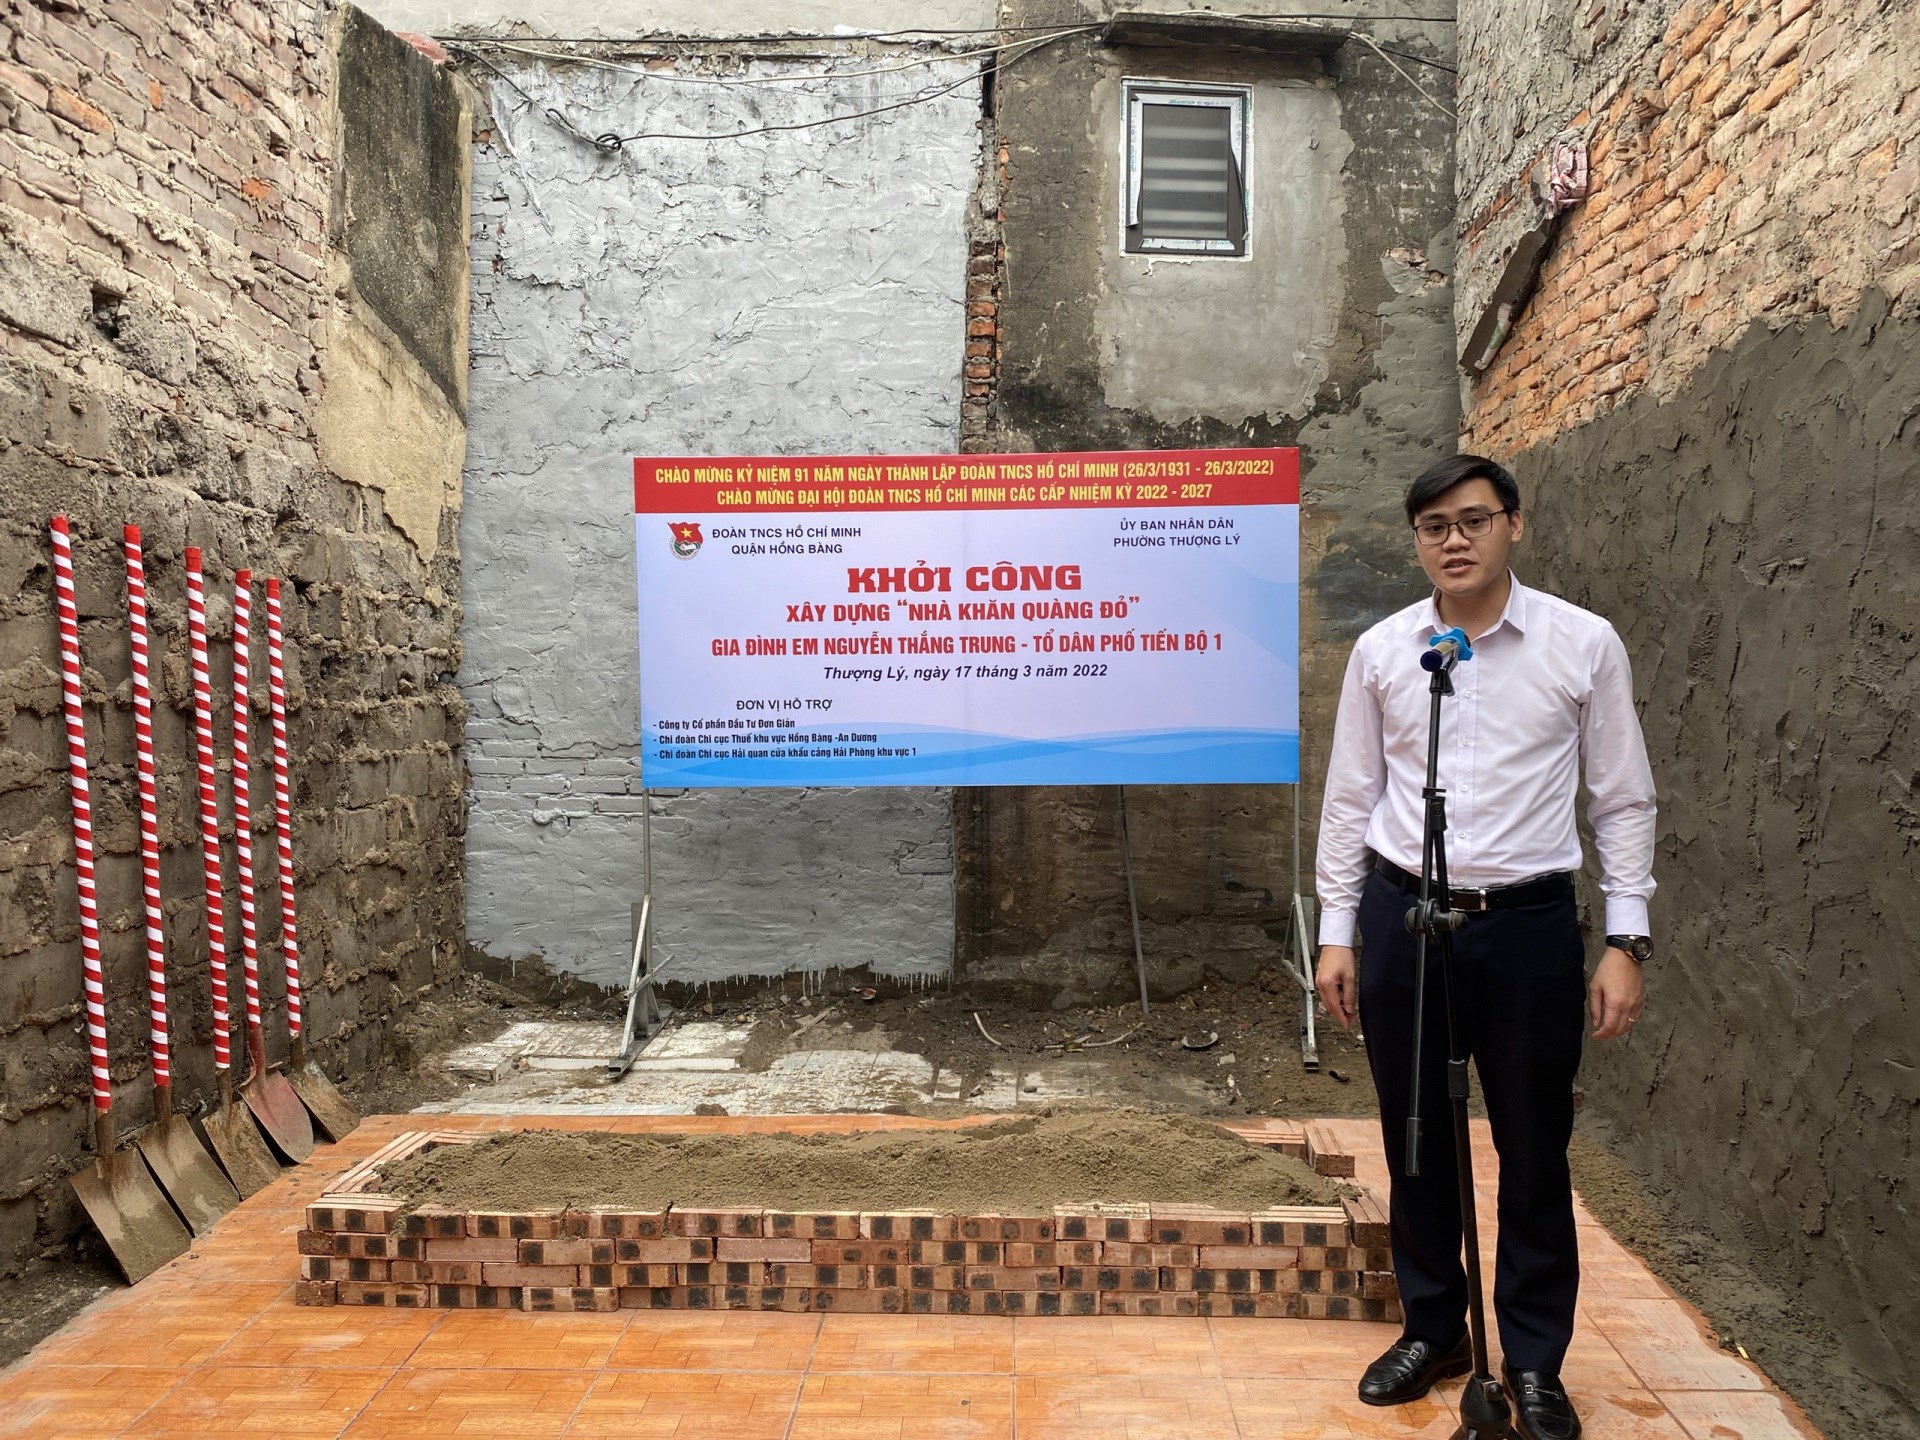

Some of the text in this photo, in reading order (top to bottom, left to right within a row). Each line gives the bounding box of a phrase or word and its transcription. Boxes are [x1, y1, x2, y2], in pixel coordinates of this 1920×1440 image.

[655, 465, 689, 483] CHÀO
[694, 464, 733, 483] MỪNG
[737, 463, 753, 483] KỶ
[757, 465, 791, 486] NIỆM
[794, 468, 808, 482] 91
[814, 464, 844, 482] NĂM
[848, 464, 882, 482] NGÀY
[886, 463, 928, 481] THÀNH
[932, 462, 956, 483] LẬP
[961, 462, 995, 480] ĐOÀN
[1000, 464, 1033, 480] TNCS
[1037, 459, 1054, 479] HỒ
[1058, 461, 1080, 478] CHÍ
[1084, 463, 1118, 478] MINH
[1123, 461, 1190, 479] (26/3/1931
[1204, 460, 1274, 476] 26/3/2022)
[717, 487, 751, 505] CHÀO
[755, 487, 794, 504] MỪNG
[798, 489, 819, 507] ĐẠI
[824, 486, 845, 506] HỘI
[848, 486, 884, 504] ĐOÀN
[888, 488, 921, 503] TNCS
[925, 483, 942, 502] HỒ
[946, 485, 967, 502] CHÍ
[971, 488, 1006, 502] MINH
[1010, 484, 1036, 501] CÁC
[1040, 482, 1065, 501] CẤP
[1069, 483, 1111, 503] NHIỆM
[1116, 482, 1132, 500] KỲ
[1136, 485, 1168, 499] 2022
[1181, 484, 1213, 498] 2027
[712, 524, 861, 538] ĐOÀN TNCS HỒ CHÍ MINH
[1120, 516, 1234, 531] ỦY BAN NHÂN DÂN
[1114, 533, 1241, 548] PHƯỜNG THƯỢNG LÝ
[731, 541, 843, 557] QUẬN HỒNG BÀNG
[847, 560, 1081, 593] KHỞI CÔNG
[786, 595, 1140, 625] XÂY DỰNG “NHÀ KHĂN QUÀNG ĐỎ”
[712, 638, 740, 656] GIA
[745, 635, 787, 656] ĐÌNH
[792, 638, 818, 655] EM
[824, 631, 892, 655] NGUYỄN
[897, 630, 954, 654] THẮNG
[959, 635, 1015, 653] TRUNG
[1033, 628, 1054, 652] TỔ
[1059, 631, 1095, 652] DÂN
[1100, 628, 1135, 652] PHỐ
[1140, 628, 1178, 651] TIẾN
[1185, 629, 1208, 654] BỘ
[1214, 634, 1222, 650] 1
[824, 664, 1108, 681] Thượng Lý, ngày 17 tháng 3 năm 2022
[736, 697, 833, 712] ĐƠN VỊ HỖ TRỢ
[659, 720, 680, 730] Công
[682, 721, 690, 730] ty
[746, 719, 756, 728] Tư
[758, 719, 774, 728] Đơn
[777, 717, 795, 728] Giản
[659, 735, 673, 744] Chi
[675, 734, 696, 744] đoàn
[698, 734, 711, 743] Chi
[714, 735, 729, 745] cục
[732, 733, 752, 743] Thuế
[754, 734, 769, 743] khu
[771, 734, 786, 744] vực
[789, 733, 809, 743] Hồng
[812, 733, 832, 743] Bàng
[851, 733, 877, 743] Dương
[660, 750, 673, 759] Chi
[676, 749, 696, 759] đoàn
[698, 749, 712, 758] Chi
[714, 750, 729, 760] cục
[732, 748, 745, 758] Hải
[748, 749, 768, 759] quan
[771, 748, 786, 758] của
[788, 747, 808, 757] khẩu
[811, 747, 831, 758] cảng
[833, 746, 847, 757] Hải
[849, 747, 875, 757] Phòng
[877, 747, 892, 756] khu
[895, 748, 909, 758] vực
[912, 747, 916, 756] 1
